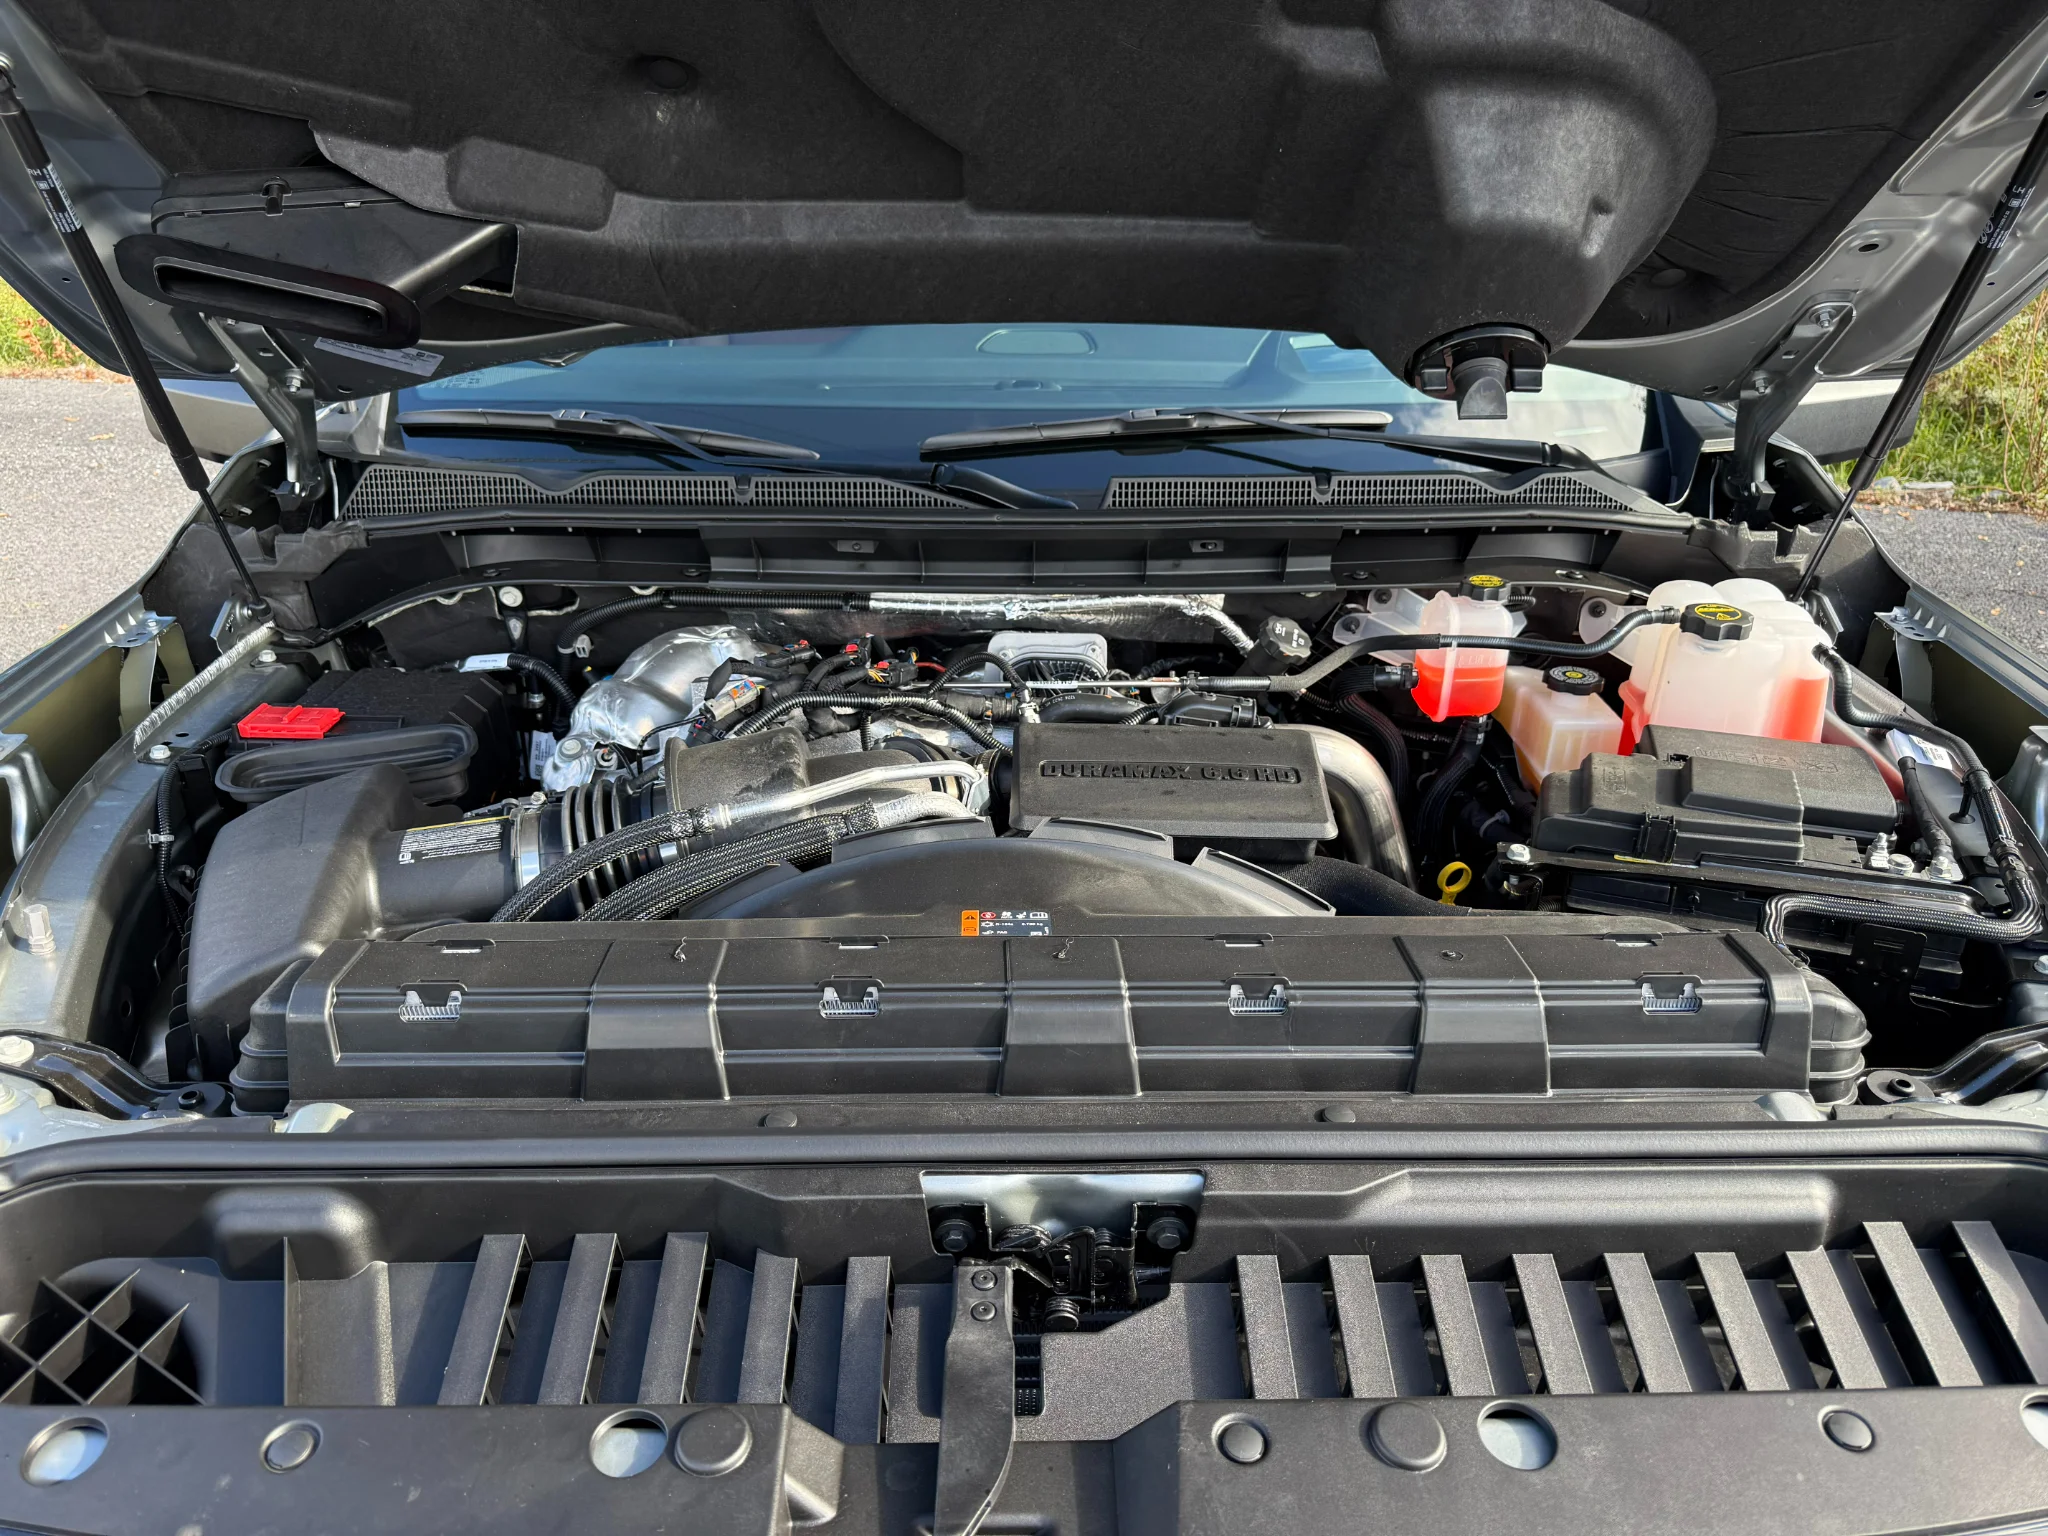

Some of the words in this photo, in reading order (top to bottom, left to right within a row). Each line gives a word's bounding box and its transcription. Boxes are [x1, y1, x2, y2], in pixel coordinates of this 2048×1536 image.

[27, 168, 42, 176] RH
[2012, 185, 2026, 194] LH
[1041, 763, 1192, 780] DURAMAX
[1201, 766, 1249, 781] 6.6
[1254, 767, 1298, 783] HD
